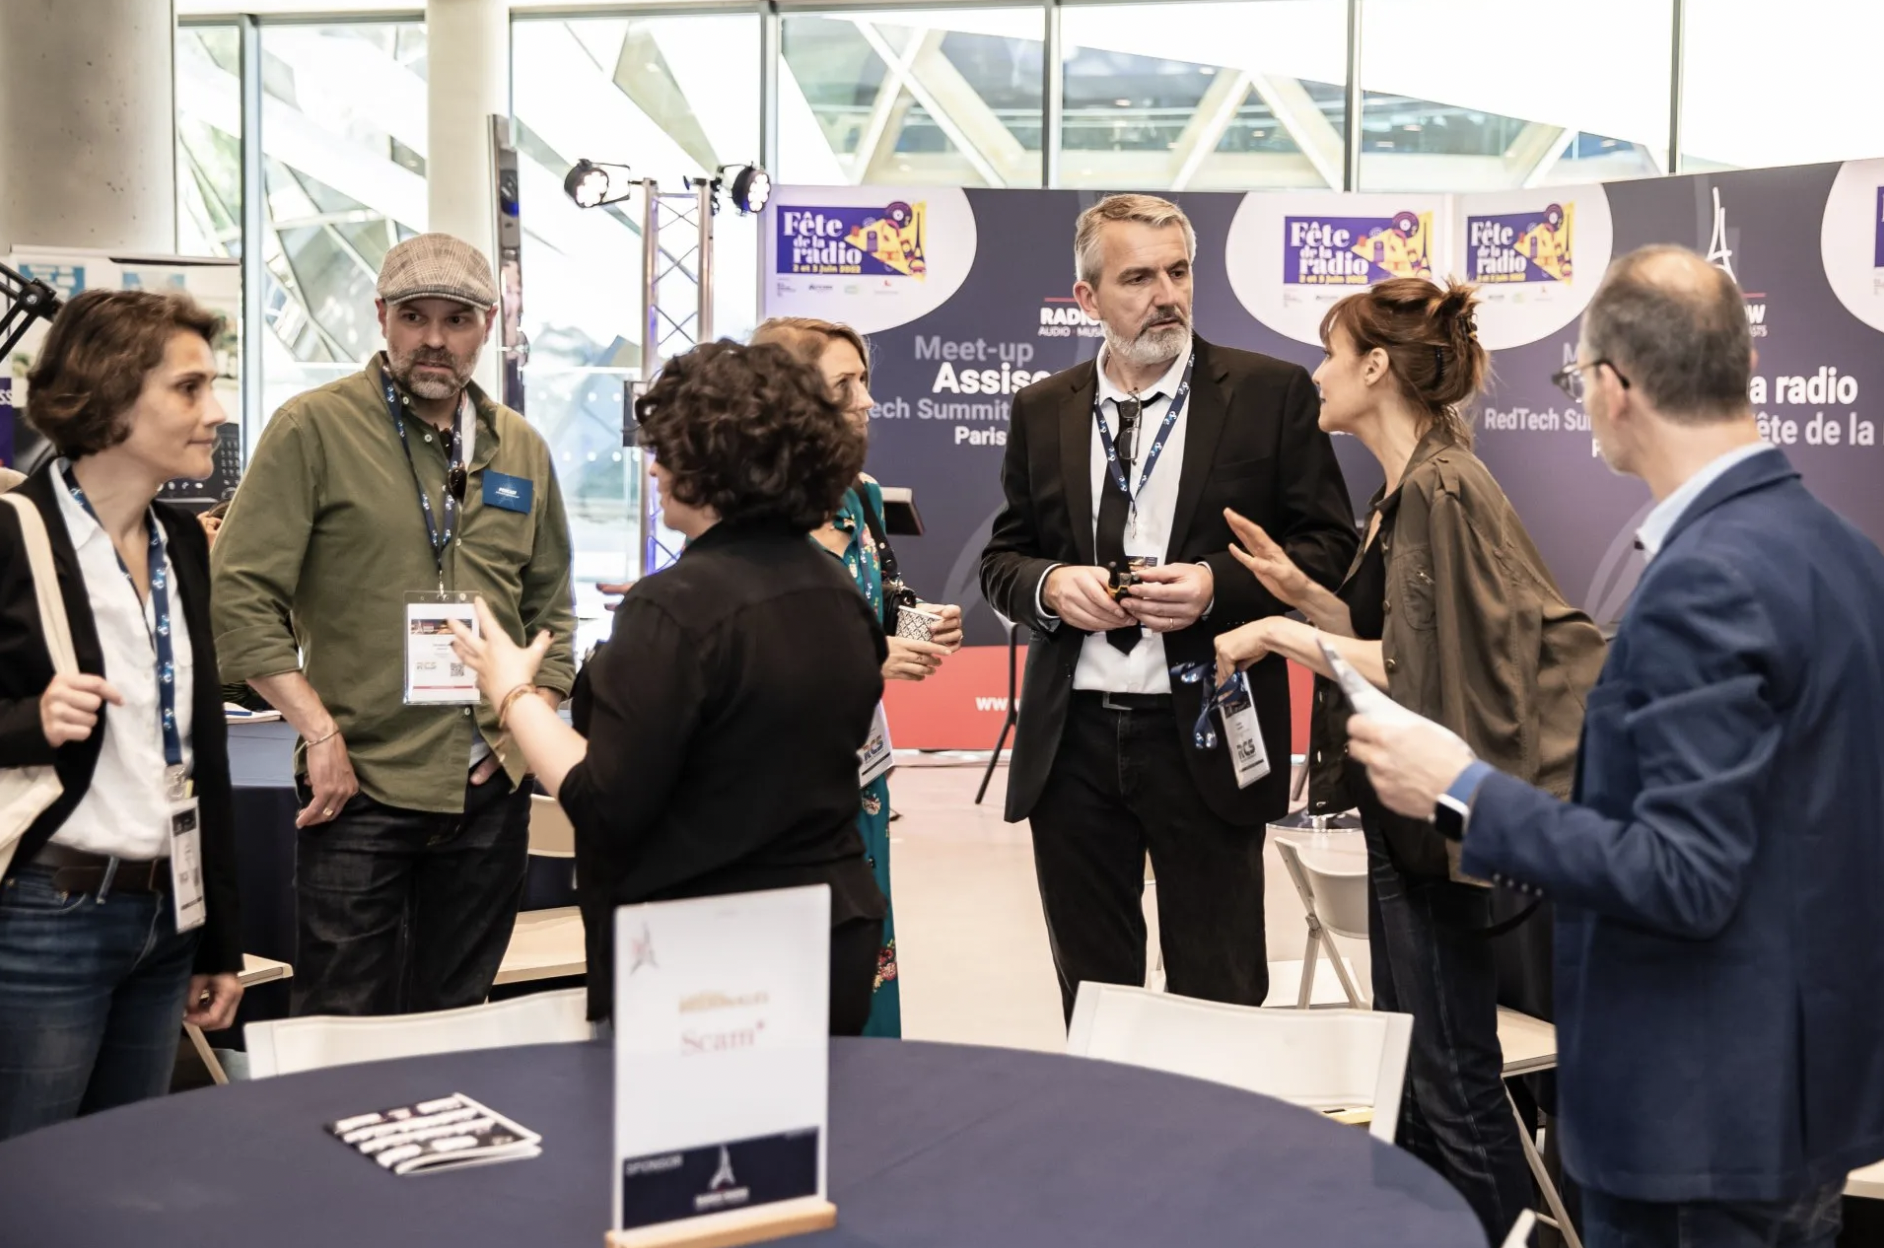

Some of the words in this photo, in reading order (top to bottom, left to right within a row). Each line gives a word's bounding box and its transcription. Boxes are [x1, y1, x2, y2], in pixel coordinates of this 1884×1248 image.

[784, 211, 843, 237] Fête
[1290, 221, 1350, 247] Fête
[1471, 220, 1514, 246] Fête
[793, 241, 863, 265] radio
[1299, 251, 1370, 276] radio
[1476, 248, 1527, 274] radio
[1038, 325, 1071, 337] AUDIO
[914, 335, 1034, 369] Meet-up
[1749, 375, 1767, 405] a
[1775, 365, 1858, 405] radio
[869, 396, 911, 420] ech
[917, 399, 1011, 421] Summit
[1484, 406, 1560, 431] RedTech
[955, 426, 1007, 446] Paris
[1756, 411, 1799, 445] ête
[1805, 411, 1841, 446] de
[1849, 411, 1875, 446] la
[1236, 738, 1256, 760] RCS
